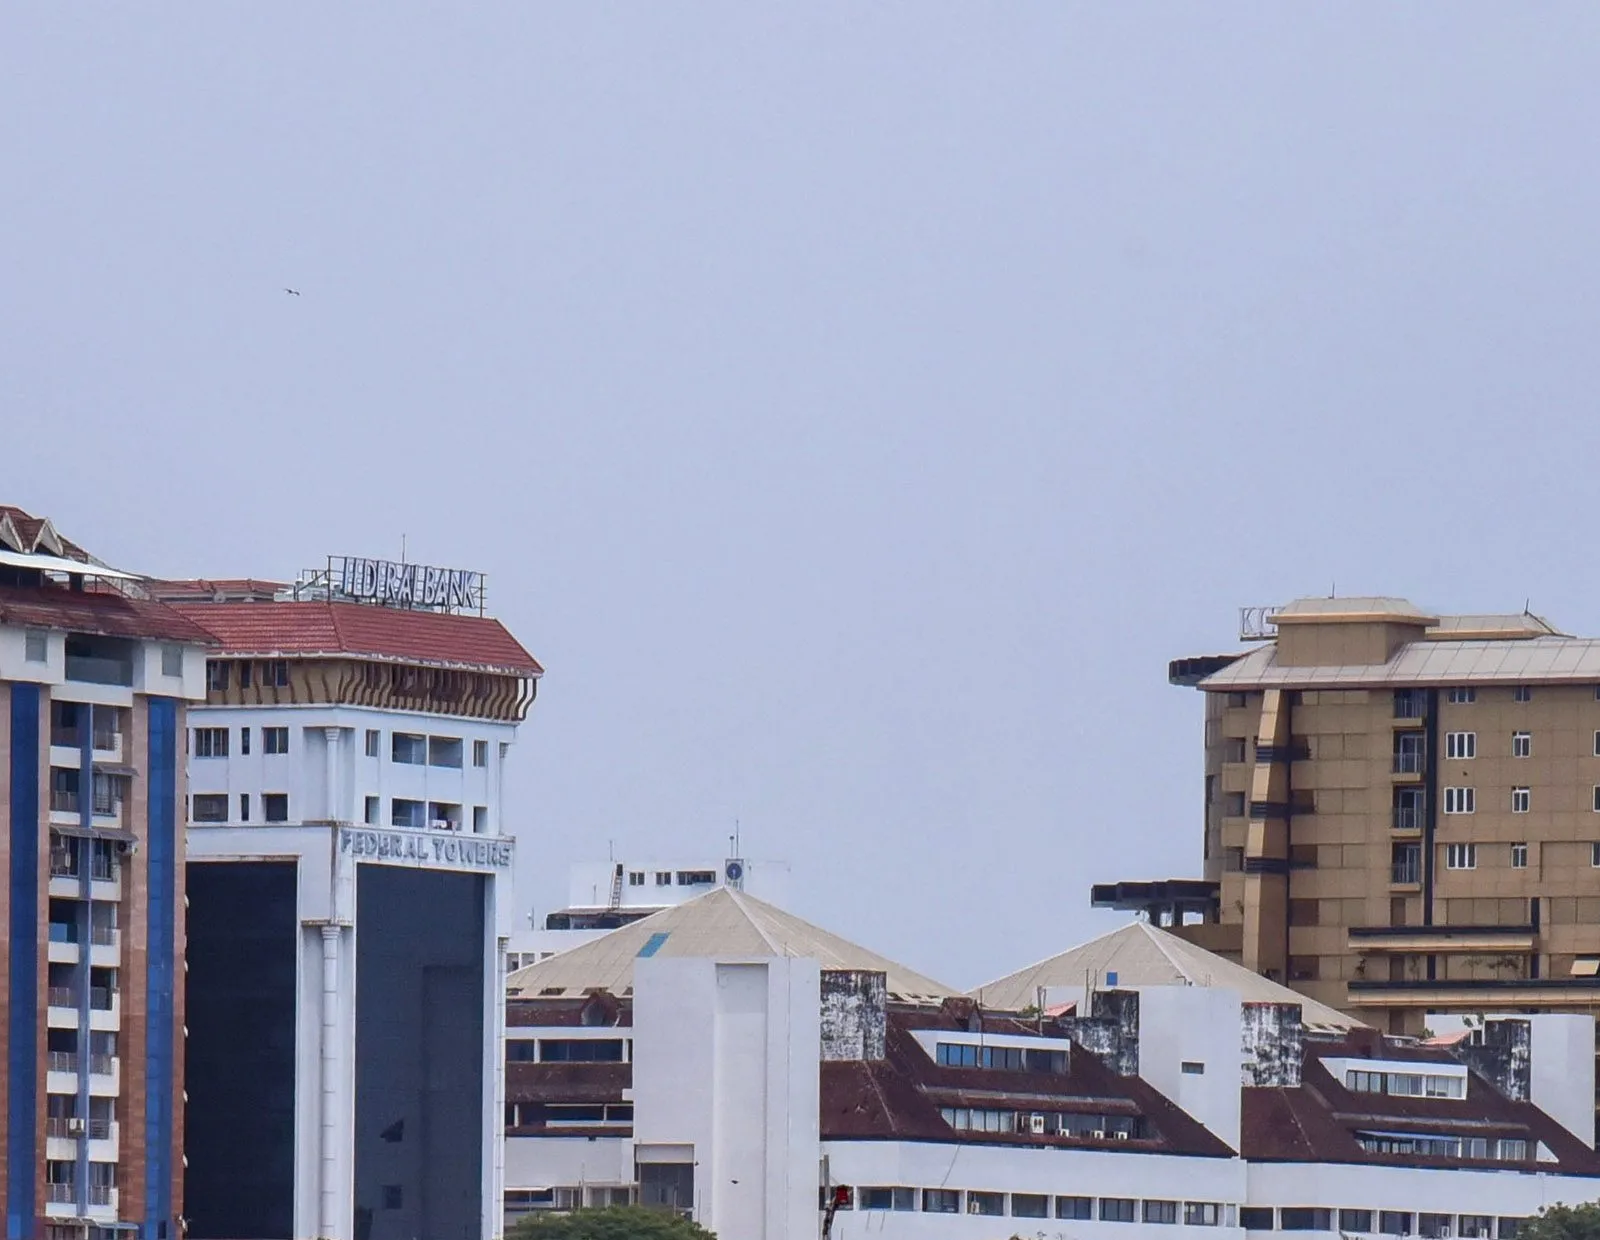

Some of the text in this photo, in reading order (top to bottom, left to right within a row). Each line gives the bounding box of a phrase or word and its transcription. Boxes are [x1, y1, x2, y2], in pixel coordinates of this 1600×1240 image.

[343, 557, 476, 608] FEDERAL BANK
[340, 830, 511, 866] FEDERAL TOWERS
